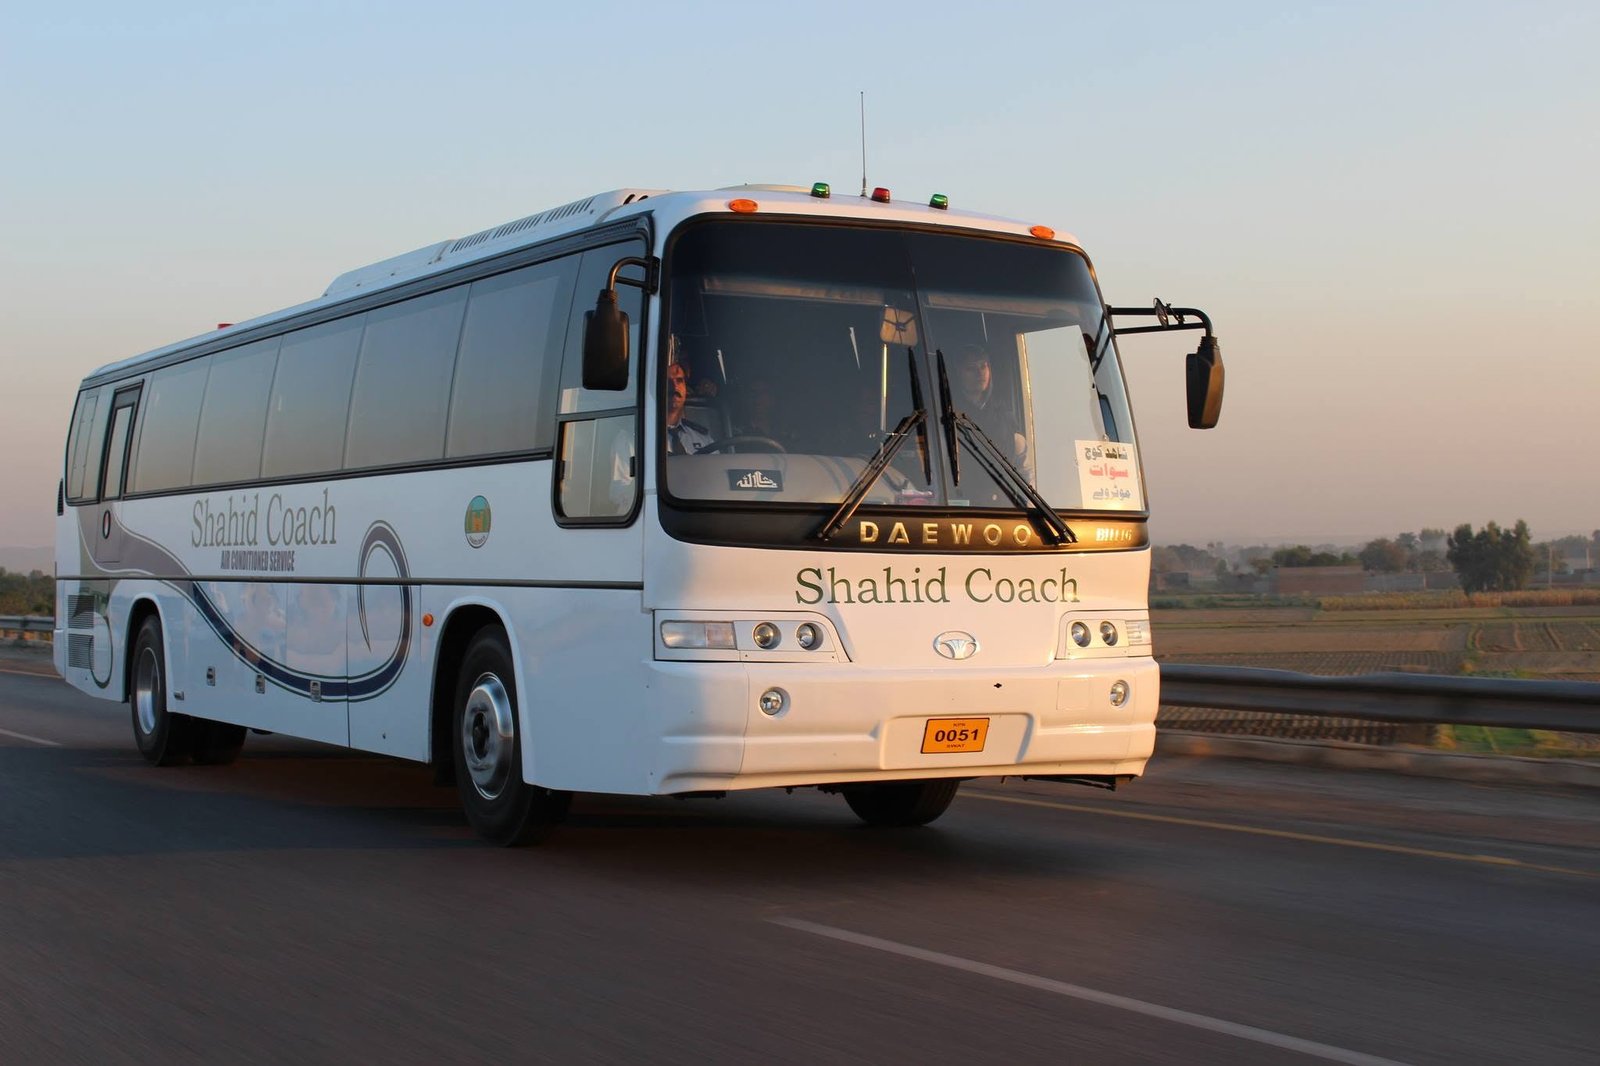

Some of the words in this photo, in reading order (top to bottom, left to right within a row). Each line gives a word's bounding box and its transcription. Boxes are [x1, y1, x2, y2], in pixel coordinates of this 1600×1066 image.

[191, 492, 259, 548] Shahid
[266, 487, 337, 547] Coach
[859, 520, 1034, 546] DAEWOO
[221, 550, 231, 570] AIR
[231, 550, 269, 571] CONDITIONED
[269, 550, 295, 572] SERVICE
[795, 566, 951, 605] Shahid
[964, 567, 1081, 604] Coach
[934, 728, 979, 743] 0051
